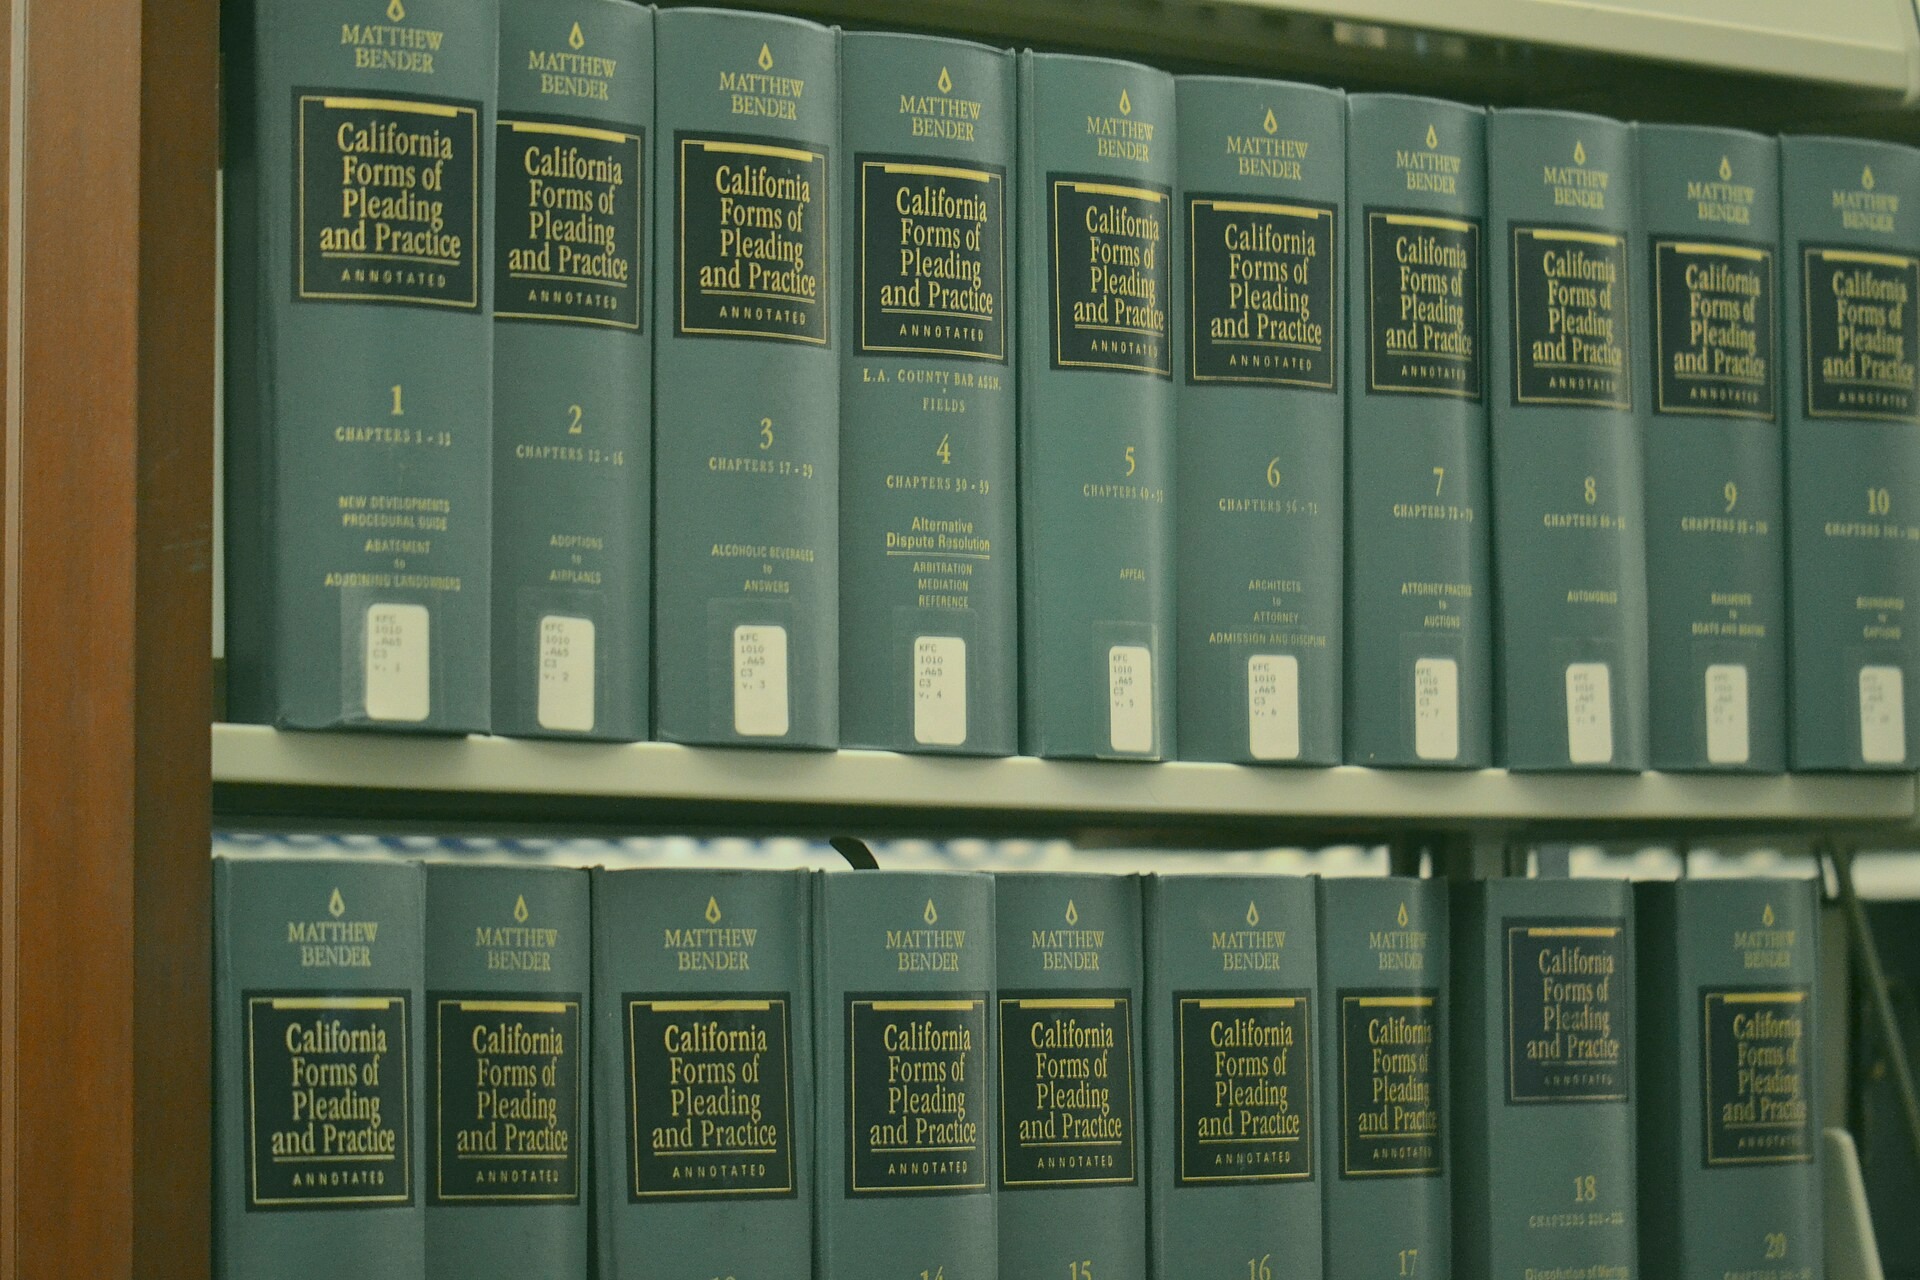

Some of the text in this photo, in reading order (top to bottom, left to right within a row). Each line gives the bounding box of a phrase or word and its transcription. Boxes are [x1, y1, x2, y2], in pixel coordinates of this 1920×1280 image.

[341, 25, 443, 49] MATTHEW
[355, 49, 434, 73] BENDER
[719, 71, 804, 97] MATTHEW
[732, 94, 797, 120] BENDER
[900, 95, 981, 120] MATTHEW
[337, 121, 453, 160] California
[912, 117, 974, 141] BENDER
[1087, 116, 1153, 141] MATTHEW
[1098, 138, 1149, 162] BENDER
[1227, 135, 1308, 159] MATTHEW
[342, 156, 442, 191] Forms of
[1239, 157, 1301, 180] BENDER
[1396, 150, 1460, 174] MATTHEW
[716, 165, 810, 203] California
[1407, 172, 1456, 195] BENDER
[343, 188, 442, 230] Pleading
[721, 198, 803, 232] Forms of
[896, 186, 987, 222] California
[901, 219, 981, 251] Forms of
[1086, 205, 1159, 241] California
[321, 220, 461, 258] and Practice
[721, 229, 803, 271] Pleading
[1090, 236, 1155, 270] Forms of
[1225, 223, 1316, 257] California
[1396, 236, 1467, 269] California
[341, 269, 446, 288] ANNOTATED
[700, 260, 816, 296] and Practice
[901, 249, 981, 289] Pleading
[1229, 254, 1308, 284] Forms of
[1400, 266, 1462, 298] Forms of
[881, 280, 993, 313] and Practice
[1090, 266, 1155, 307] Pleading
[720, 306, 806, 325] ANNOTATED
[1074, 299, 1164, 330] and Practice
[1229, 283, 1309, 321] Pleading
[1402, 294, 1464, 332] Pleading
[900, 324, 984, 341] ANNOTATED
[1211, 312, 1322, 344] and Practice
[1386, 324, 1472, 356] and Practice
[1229, 354, 1311, 371] ANNOTATED
[864, 368, 1001, 390] L.A. COUNTY BAR ASSN.
[391, 385, 404, 416] 1
[923, 397, 965, 413] FIELDS
[569, 405, 583, 434] 2
[760, 418, 773, 449] 3
[936, 433, 950, 464] 4
[1125, 447, 1135, 477] 5
[709, 457, 774, 473] CHAPTERS
[1267, 457, 1281, 488] 6
[886, 475, 950, 490] CHAPTERS
[956, 478, 967, 492] 30
[1433, 467, 1443, 496] 7
[1585, 476, 1596, 505] 8
[1219, 498, 1281, 513] CHAPTERS
[1725, 482, 1737, 513] 9
[1868, 488, 1890, 516] 10
[912, 517, 973, 534] Alternative
[712, 544, 768, 559] ALCOHOLIC
[887, 532, 990, 552] Dispute Resolution
[913, 562, 972, 575] ARBITRATION
[1120, 568, 1145, 581] APPEAL
[744, 579, 789, 593] ANSWERS
[919, 579, 968, 591] MEDIATION
[1249, 580, 1300, 592] ARCHITECTS
[919, 595, 968, 608] REFERENCE
[1254, 611, 1298, 625] ATTORNEY
[920, 644, 936, 652] KFC
[920, 656, 943, 664] 1010
[920, 679, 931, 687] C3
[287, 922, 378, 943] MATTHEW
[664, 928, 757, 949] MATTHEW
[1032, 930, 1104, 949] MATTHEW
[1212, 932, 1285, 949] MATTHEW
[301, 945, 371, 967] BENDER
[678, 951, 750, 970] BENDER
[1043, 952, 1099, 970] BENDER
[1223, 953, 1280, 970] BENDER
[286, 1020, 387, 1054] California
[664, 1022, 767, 1054] California
[883, 1022, 971, 1052] California
[1031, 1019, 1114, 1049] California
[1210, 1019, 1293, 1048] California
[1368, 1016, 1432, 1047] California
[292, 1054, 380, 1087] Forms of
[670, 1053, 759, 1085] Forms of
[889, 1052, 965, 1084] Forms of
[1036, 1051, 1108, 1079] Forms of
[1215, 1048, 1287, 1078] Forms of
[1373, 1048, 1428, 1074] Forms of
[671, 1085, 761, 1123] Pleading
[889, 1084, 965, 1122] Pleading
[1037, 1080, 1109, 1117] Pleading
[1216, 1079, 1287, 1114] Pleading
[1373, 1077, 1429, 1108] Pleading
[292, 1089, 380, 1126] Pleading
[1359, 1105, 1437, 1134] and Practice
[653, 1118, 777, 1149] and Practice
[870, 1116, 976, 1145] and Practice
[1020, 1112, 1122, 1141] and Practice
[1198, 1110, 1300, 1138] and Practice
[272, 1122, 395, 1155] and Practice
[673, 1165, 766, 1178] ANNOTATED
[888, 1161, 967, 1175] ANNOTATED
[1038, 1155, 1113, 1168] ANNOTATED
[1216, 1152, 1290, 1165] ANNOTATED
[293, 1170, 384, 1186] ANNOTATED
[1574, 1176, 1596, 1202] 18
[1069, 1260, 1091, 1280] 15
[1248, 1254, 1271, 1280] 16
[1399, 1249, 1418, 1276] 17
